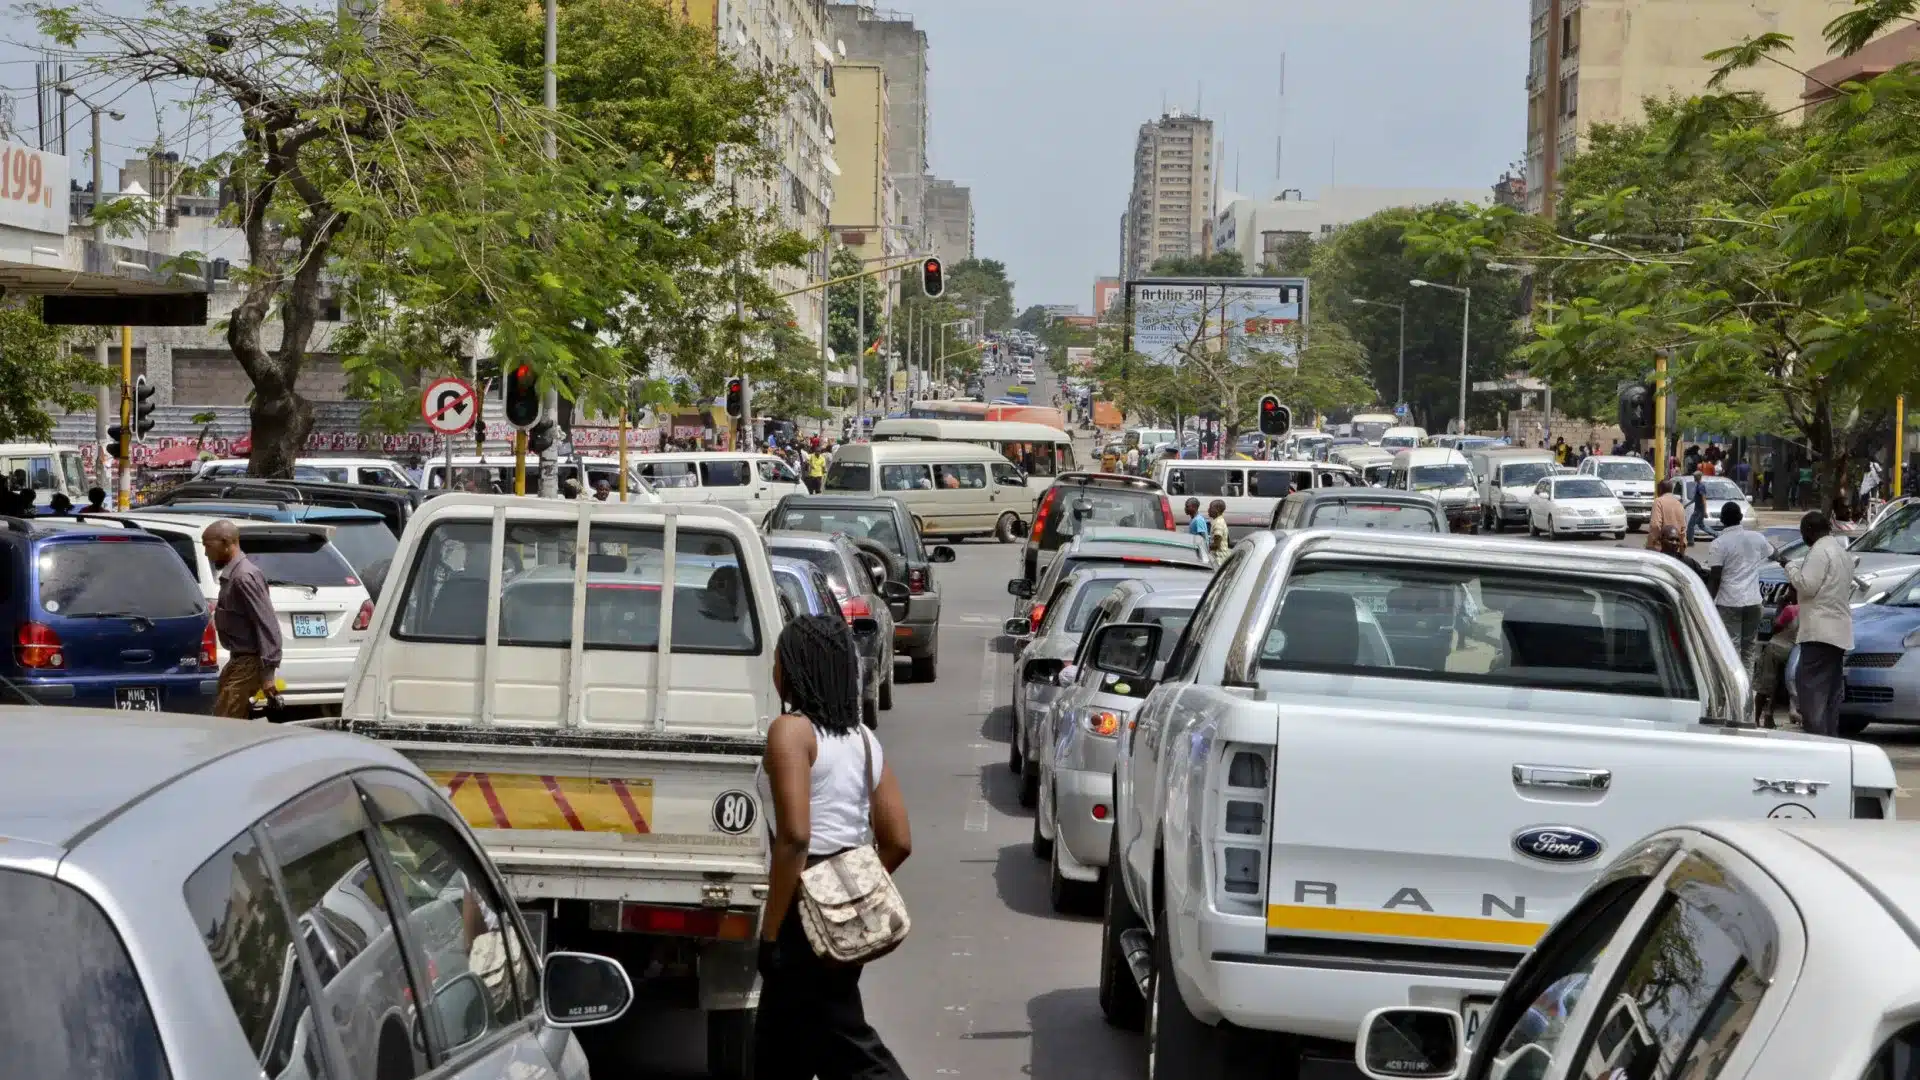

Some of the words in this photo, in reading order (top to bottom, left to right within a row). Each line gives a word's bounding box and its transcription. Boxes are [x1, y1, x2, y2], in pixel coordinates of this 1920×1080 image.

[1, 146, 41, 204] 199
[296, 626, 311, 635] 926
[316, 626, 326, 634] MP
[127, 689, 146, 700] MMQ
[722, 795, 747, 829] 80
[1533, 832, 1584, 855] Ford
